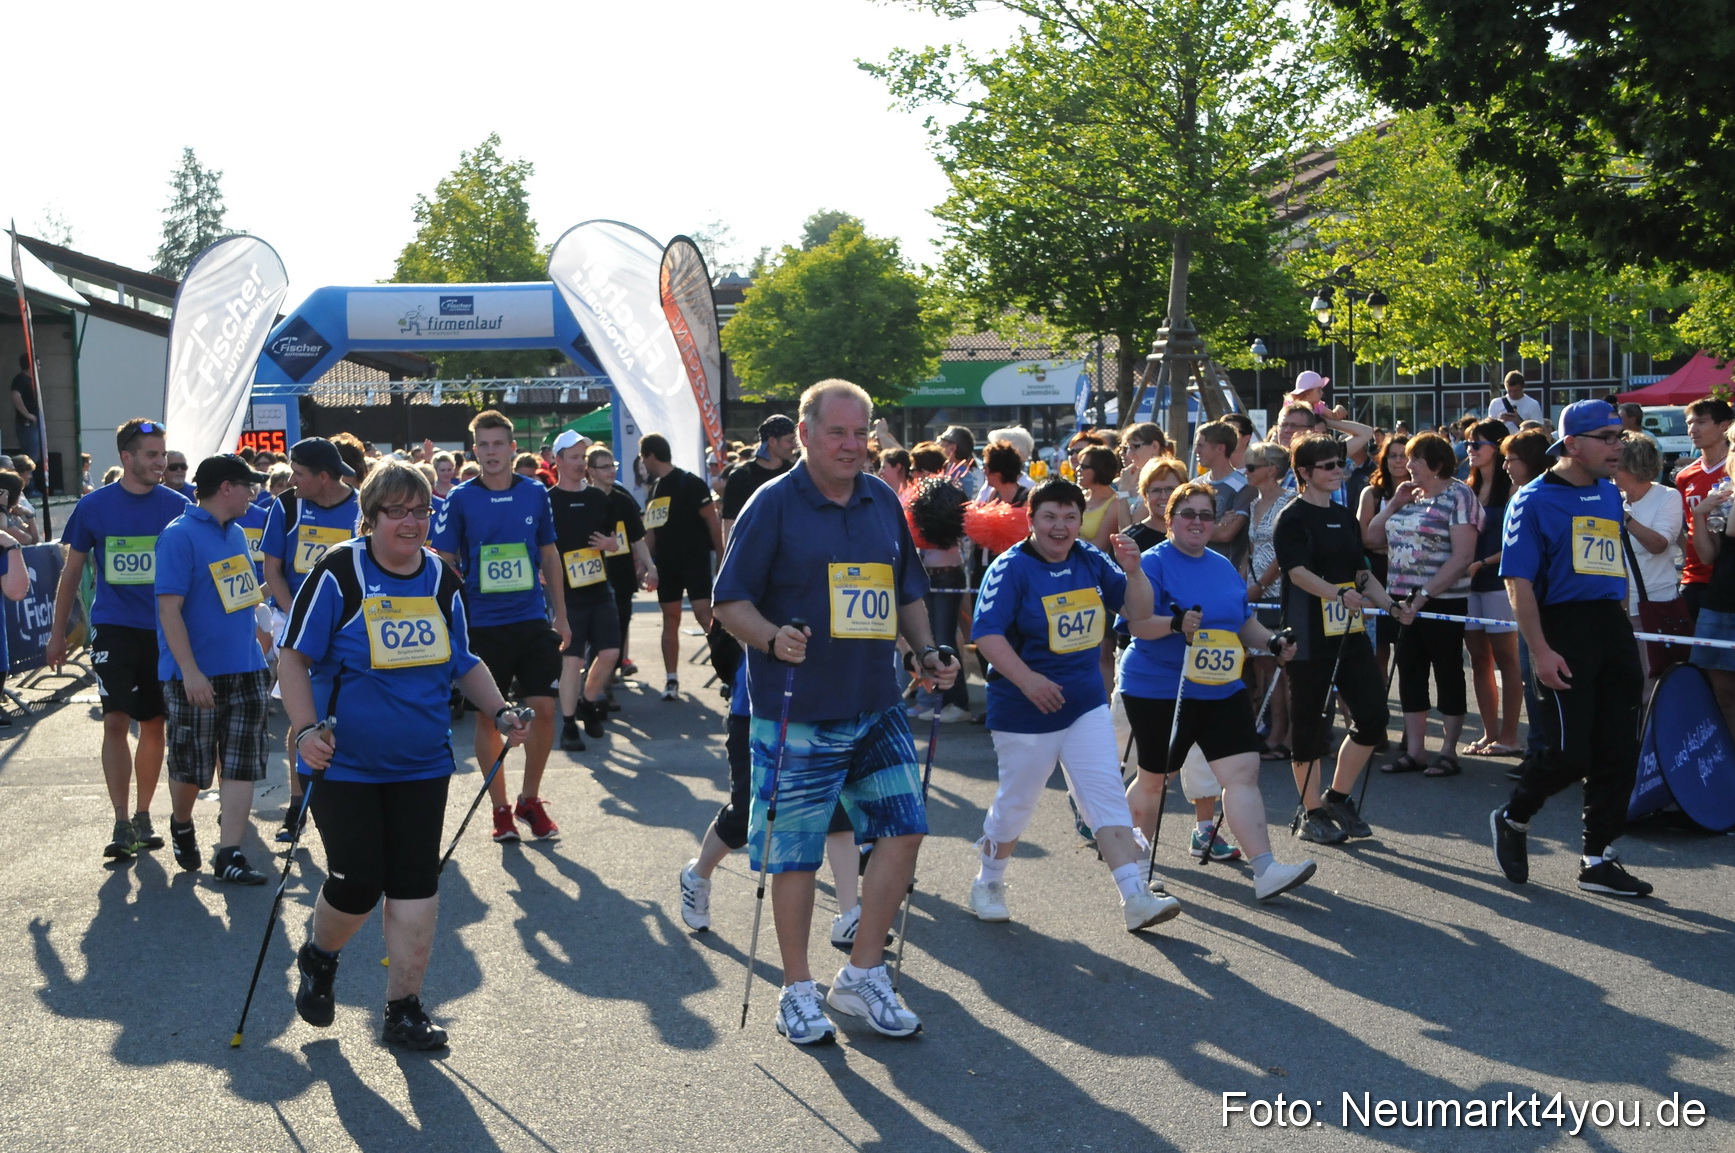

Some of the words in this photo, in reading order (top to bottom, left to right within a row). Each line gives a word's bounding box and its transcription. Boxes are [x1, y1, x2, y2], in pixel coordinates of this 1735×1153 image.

[196, 263, 265, 386] Fischer
[428, 315, 504, 330] firmenlauf
[223, 286, 271, 385] AUTOMOBILE
[279, 342, 323, 353] Fischer
[303, 542, 327, 562] 72
[1582, 536, 1615, 562] 710
[113, 553, 152, 572] 690
[488, 560, 522, 580] 681
[569, 559, 603, 578] 1129
[223, 572, 254, 598] 720
[842, 589, 890, 620] 700
[380, 619, 436, 649] 628
[1057, 609, 1096, 638] 647
[95, 651, 109, 664] 12
[1194, 648, 1235, 671] 635
